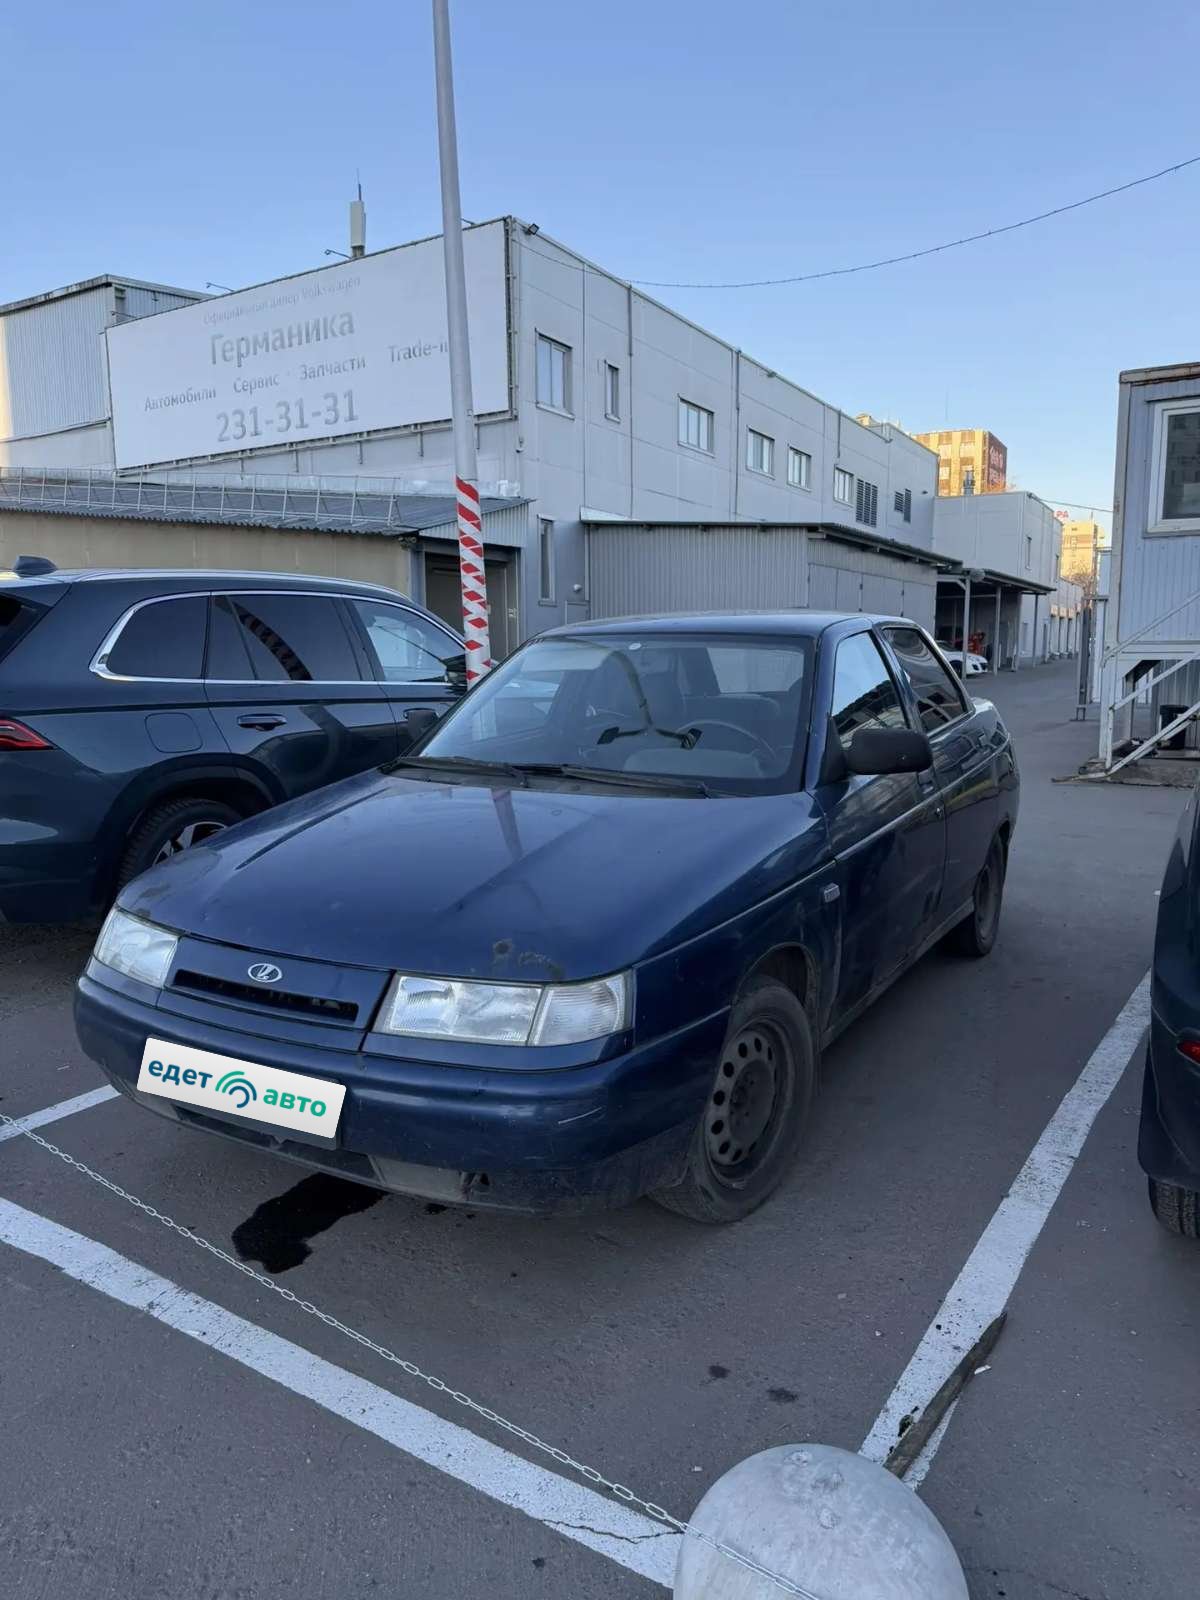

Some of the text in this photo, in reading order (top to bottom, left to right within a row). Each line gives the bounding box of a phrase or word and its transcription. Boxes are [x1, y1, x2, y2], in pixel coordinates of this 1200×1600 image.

[210, 311, 355, 368] Германика
[144, 386, 216, 412] Автомобили
[233, 373, 281, 394] Сервис
[300, 355, 366, 381] Запчасти
[217, 388, 359, 443] 231-31-31
